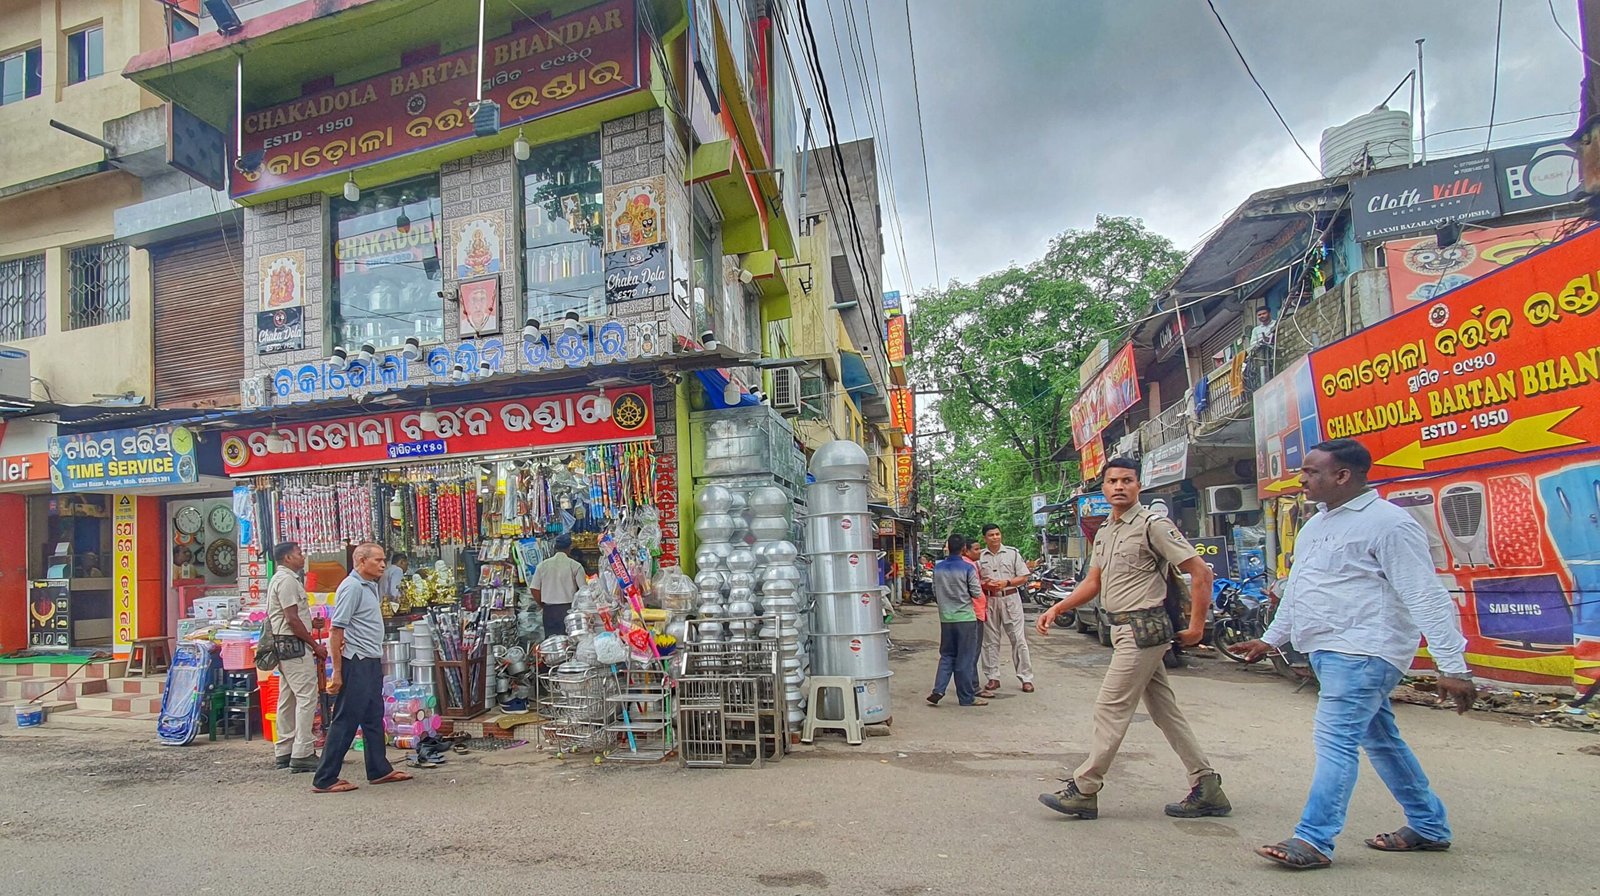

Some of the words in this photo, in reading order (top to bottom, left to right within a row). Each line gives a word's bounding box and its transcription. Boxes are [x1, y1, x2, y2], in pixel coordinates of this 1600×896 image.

[245, 84, 378, 134] CHAKADOLA
[494, 8, 624, 66] BHANDAR
[263, 130, 302, 149] ESTD
[316, 116, 354, 135] 1950
[1367, 188, 1420, 213] Cloth
[1432, 178, 1483, 200] Villa
[1372, 225, 1399, 236] LAXMI
[607, 270, 640, 290] Chaka
[641, 265, 666, 284] Dola
[1326, 397, 1422, 439] CHAKADOLA
[1427, 370, 1518, 418] BARTAN
[1420, 421, 1458, 441] ESTD
[1470, 408, 1509, 430] 1950
[67, 463, 104, 480] TIME
[108, 457, 174, 477] SERVICE
[1489, 603, 1542, 616] SAMSUNG
